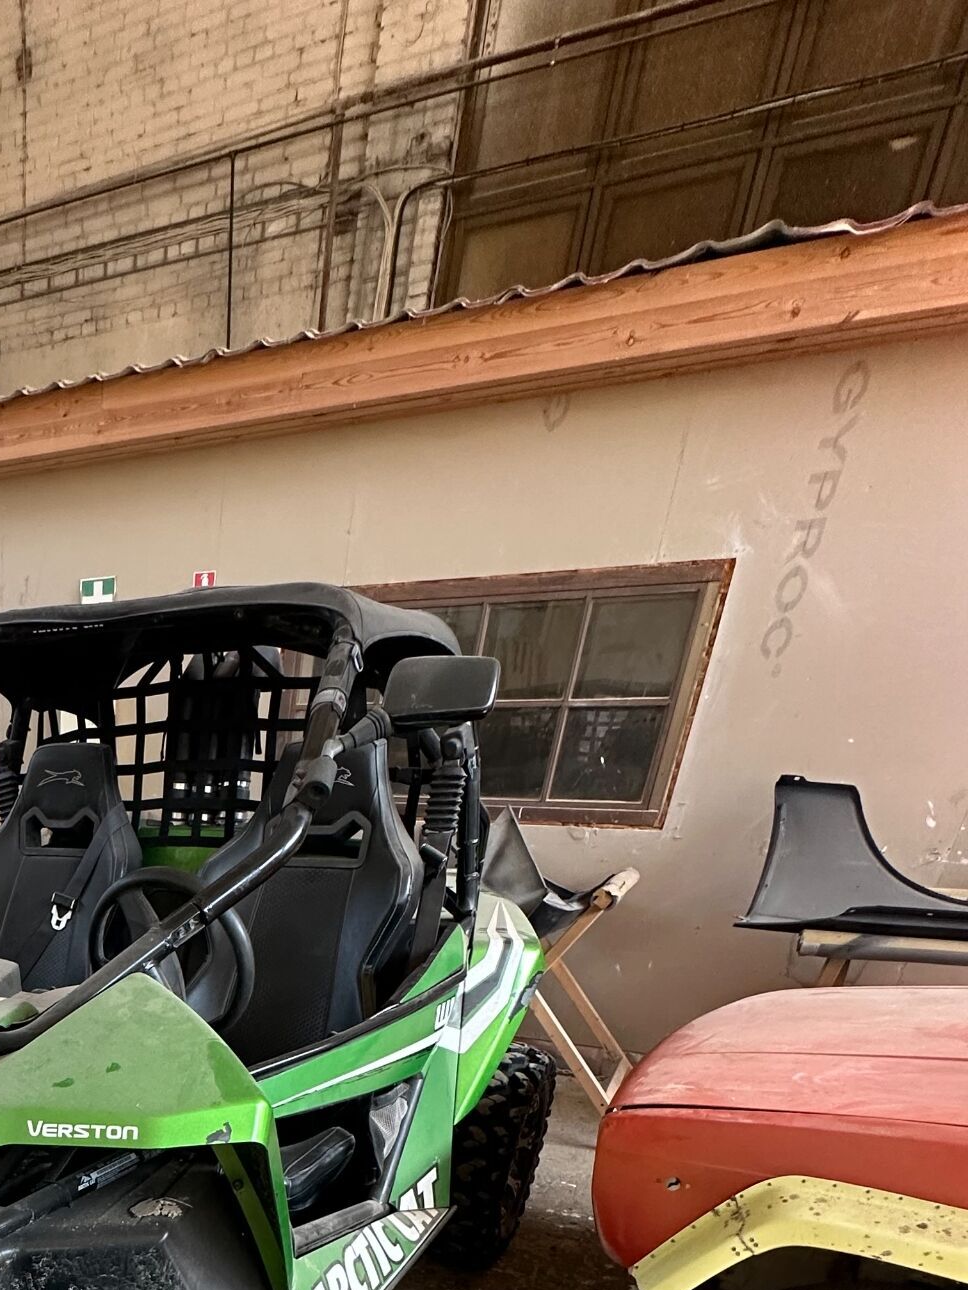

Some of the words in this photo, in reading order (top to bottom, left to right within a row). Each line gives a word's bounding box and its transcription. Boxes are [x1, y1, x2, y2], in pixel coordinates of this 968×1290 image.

[760, 358, 871, 660] GYPROC
[26, 1119, 139, 1140] VERSTON
[386, 1166, 438, 1242] CAT
